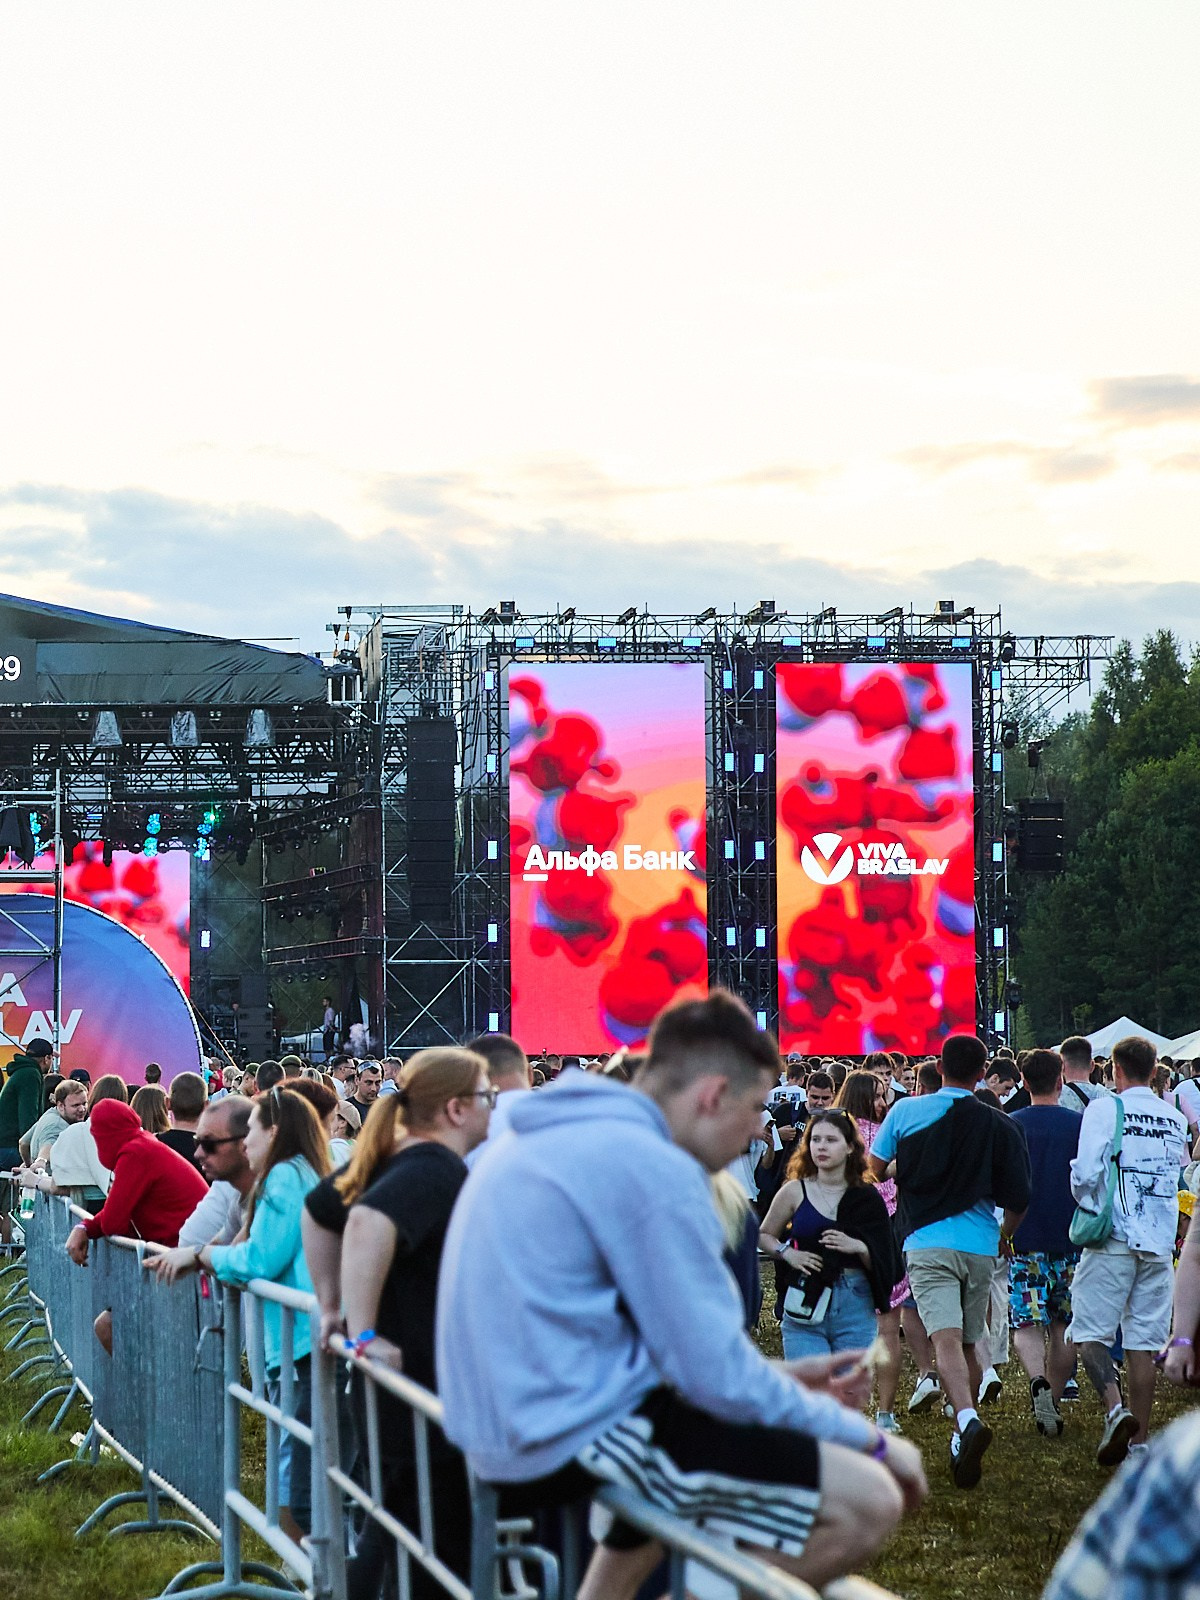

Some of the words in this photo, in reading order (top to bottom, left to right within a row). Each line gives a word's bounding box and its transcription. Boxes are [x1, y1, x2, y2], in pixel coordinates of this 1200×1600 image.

[857, 842, 908, 859] VIVA
[523, 844, 618, 877] Альфа
[623, 844, 696, 870] Банк
[857, 858, 950, 875] BRASLAV
